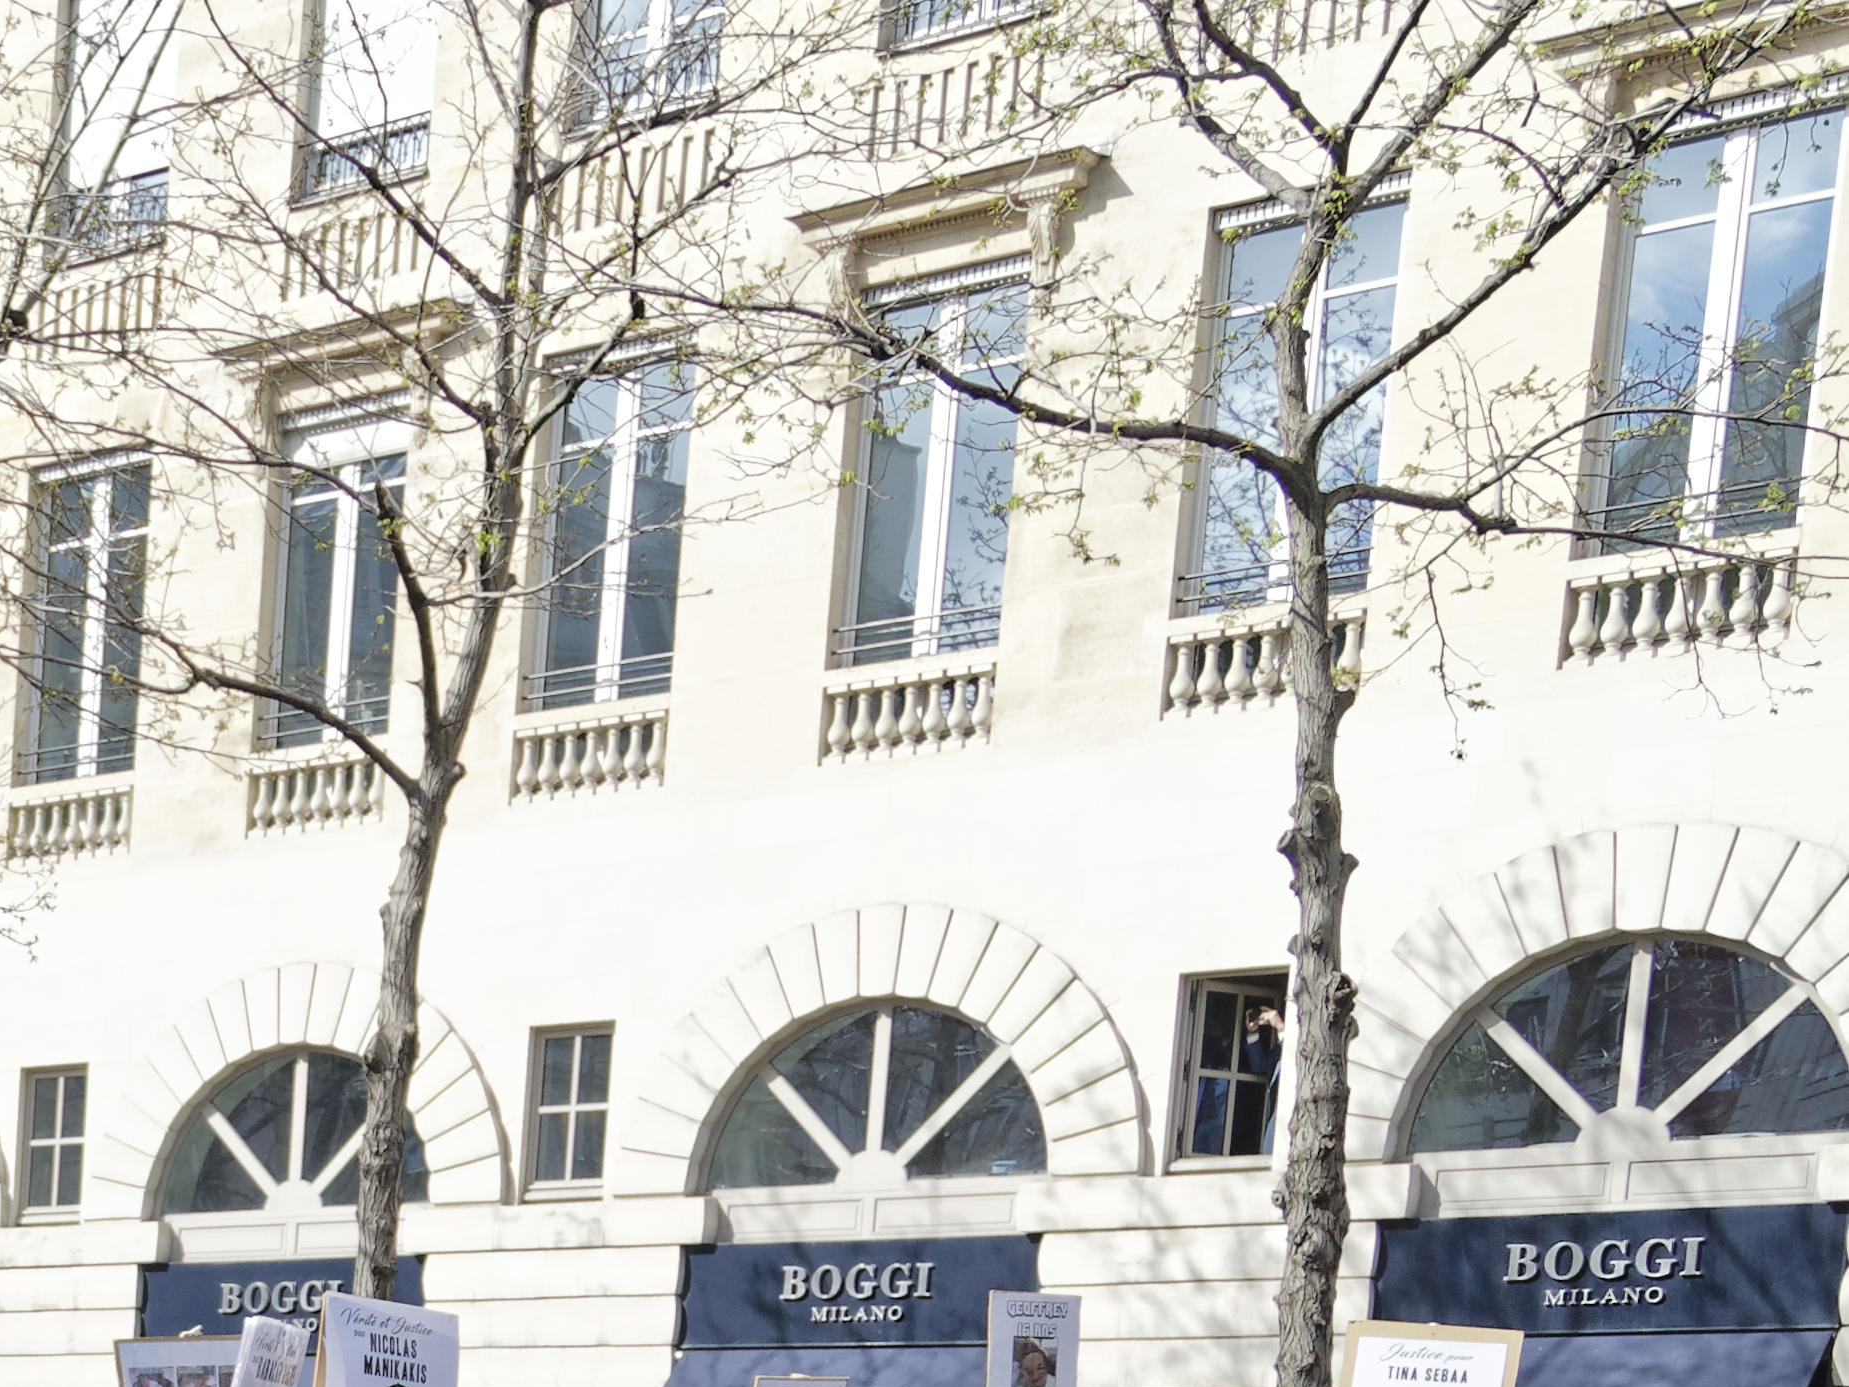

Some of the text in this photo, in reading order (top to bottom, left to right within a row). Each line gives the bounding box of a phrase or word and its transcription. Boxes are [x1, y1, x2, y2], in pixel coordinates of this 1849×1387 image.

[1503, 1235, 1707, 1284] BOGGI
[778, 1261, 935, 1302] BOGGI
[1542, 1285, 1665, 1308] MILANO
[340, 1306, 377, 1327] Vérité
[379, 1314, 396, 1329] et
[392, 1316, 434, 1335] Justice
[809, 1304, 904, 1323] MILANO
[370, 1333, 417, 1359] NICOLAS
[1380, 1343, 1475, 1365] Justice pour
[362, 1354, 427, 1384] MANIKAKIS
[1388, 1366, 1468, 1384] TINA SEBAA
